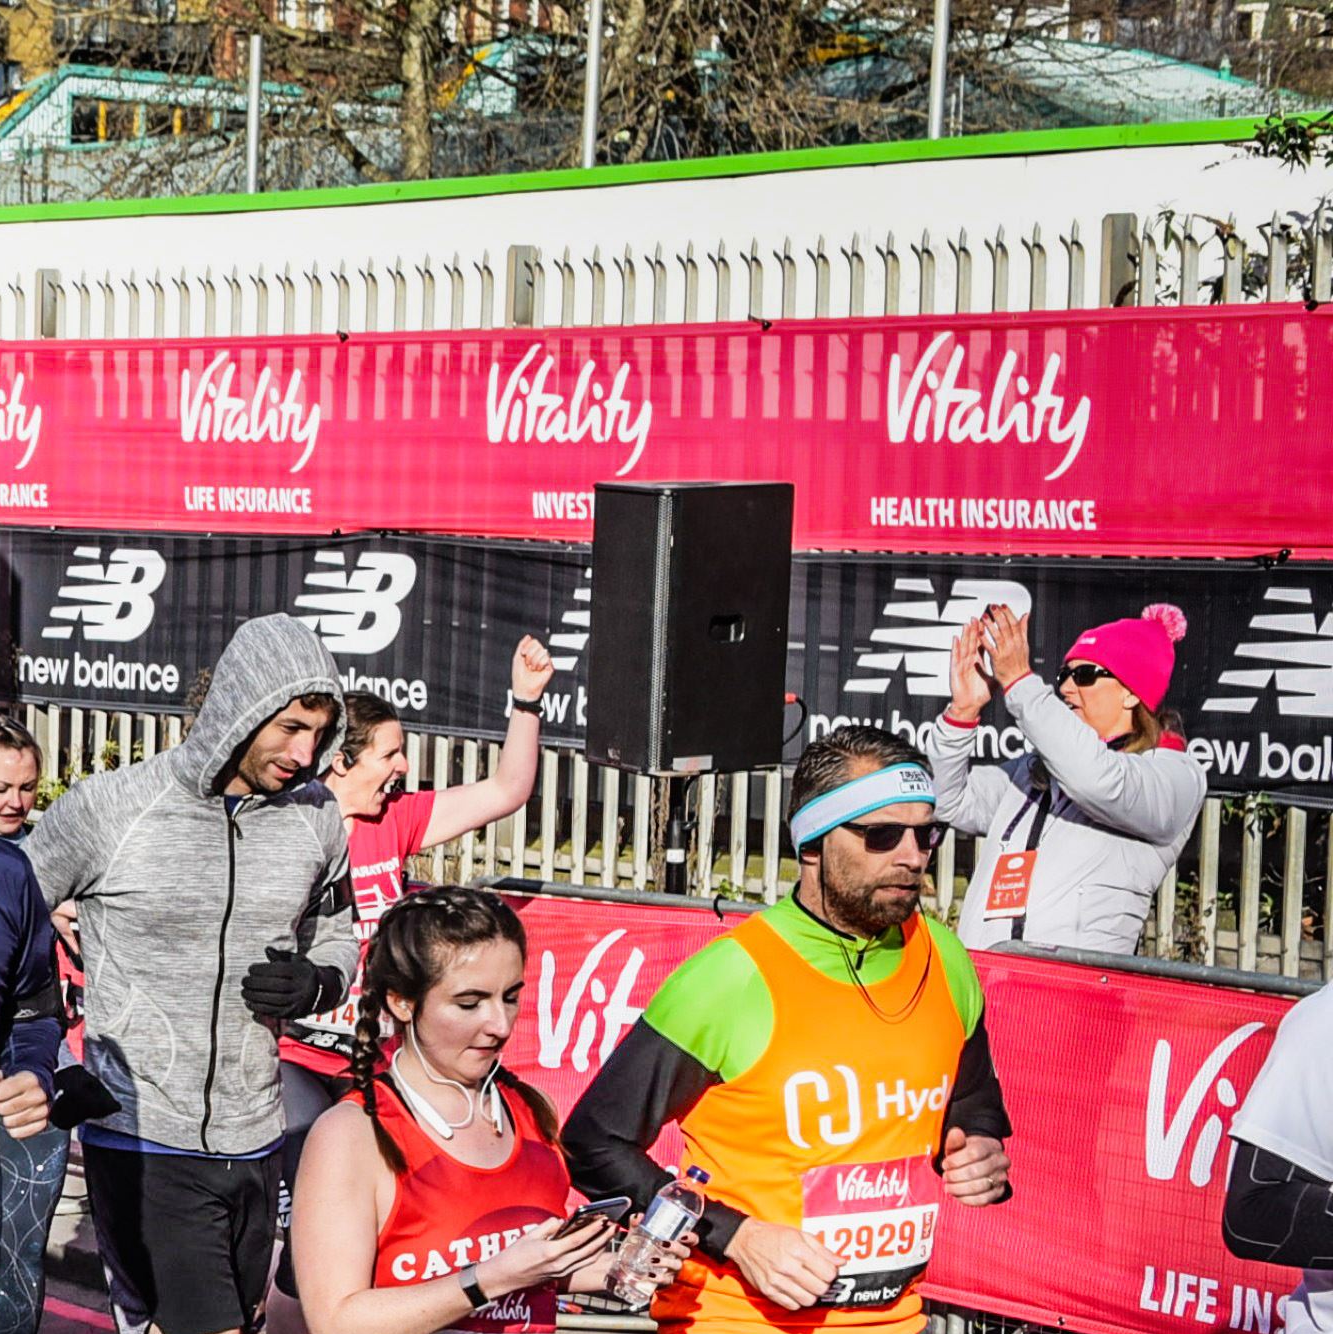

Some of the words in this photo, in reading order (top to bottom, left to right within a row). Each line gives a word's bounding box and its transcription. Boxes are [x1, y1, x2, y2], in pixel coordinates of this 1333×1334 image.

[180, 351, 321, 474] Vitality
[486, 343, 653, 476] Vitality
[887, 331, 1091, 480] Vitality
[184, 486, 216, 511] LIFE
[218, 487, 312, 514] INSURANCE
[871, 497, 955, 528] HEALTH
[961, 497, 1096, 531] INSURANCE
[19, 653, 70, 685] new
[74, 651, 180, 693] balance
[836, 1165, 909, 1206] Vitality
[1140, 1264, 1220, 1325] LIFE
